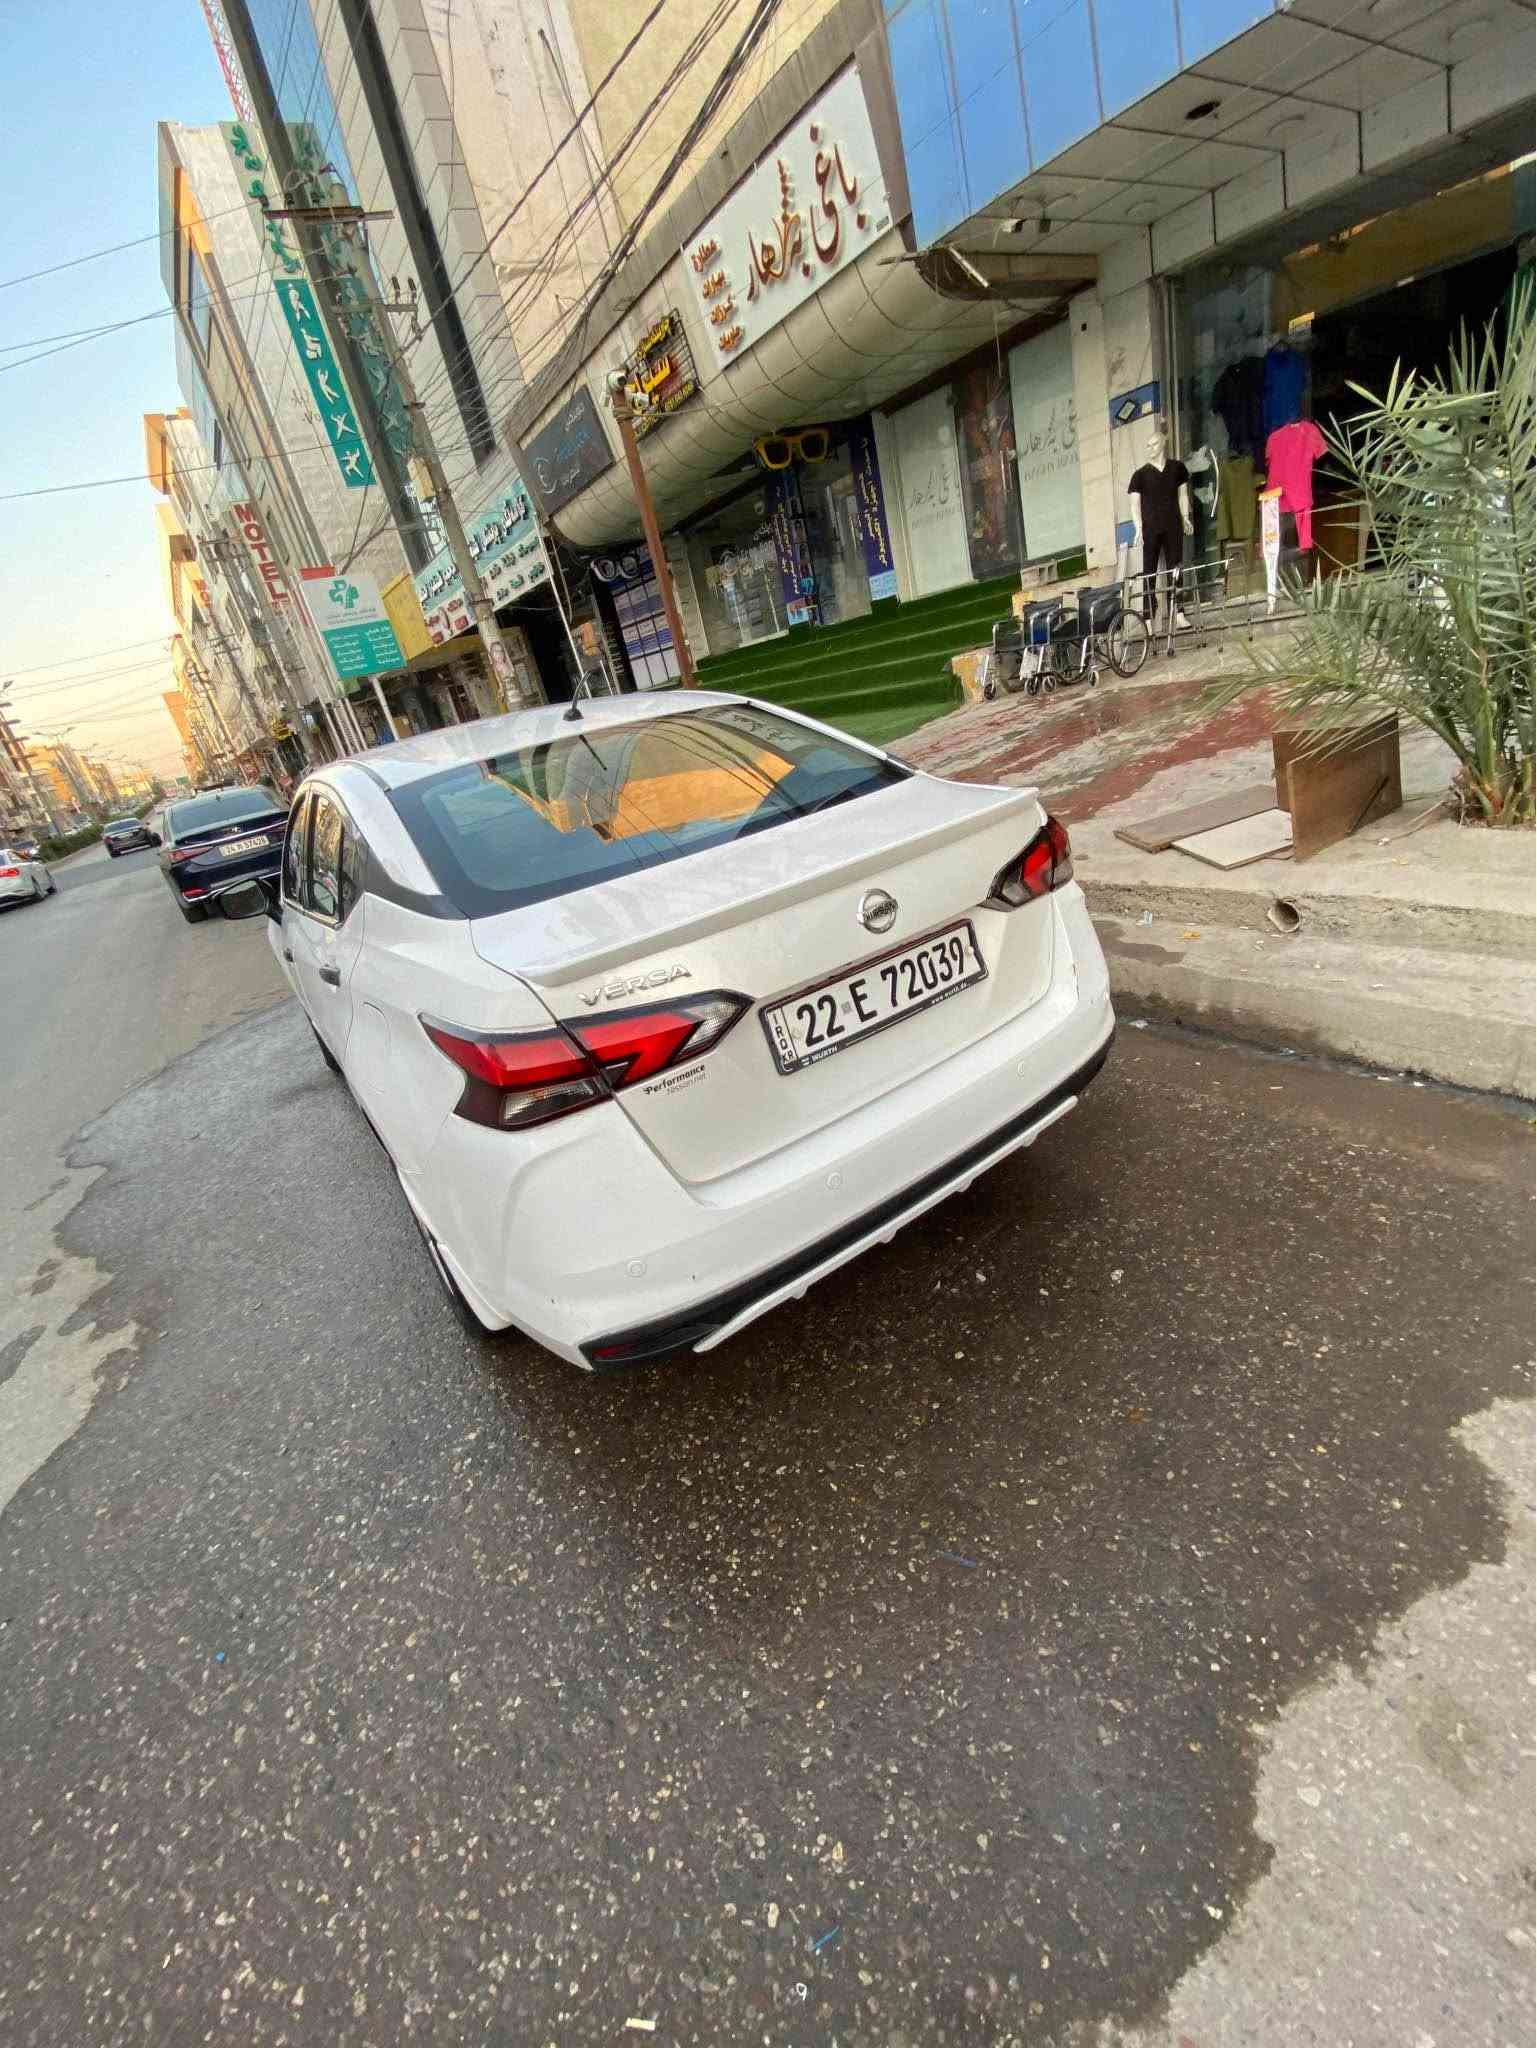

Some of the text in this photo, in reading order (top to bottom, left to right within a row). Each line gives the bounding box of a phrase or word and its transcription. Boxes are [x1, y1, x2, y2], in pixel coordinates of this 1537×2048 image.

[579, 963, 693, 1007] VERSA
[797, 936, 967, 1048] 22 E 72039
[643, 1064, 705, 1096] Performance
